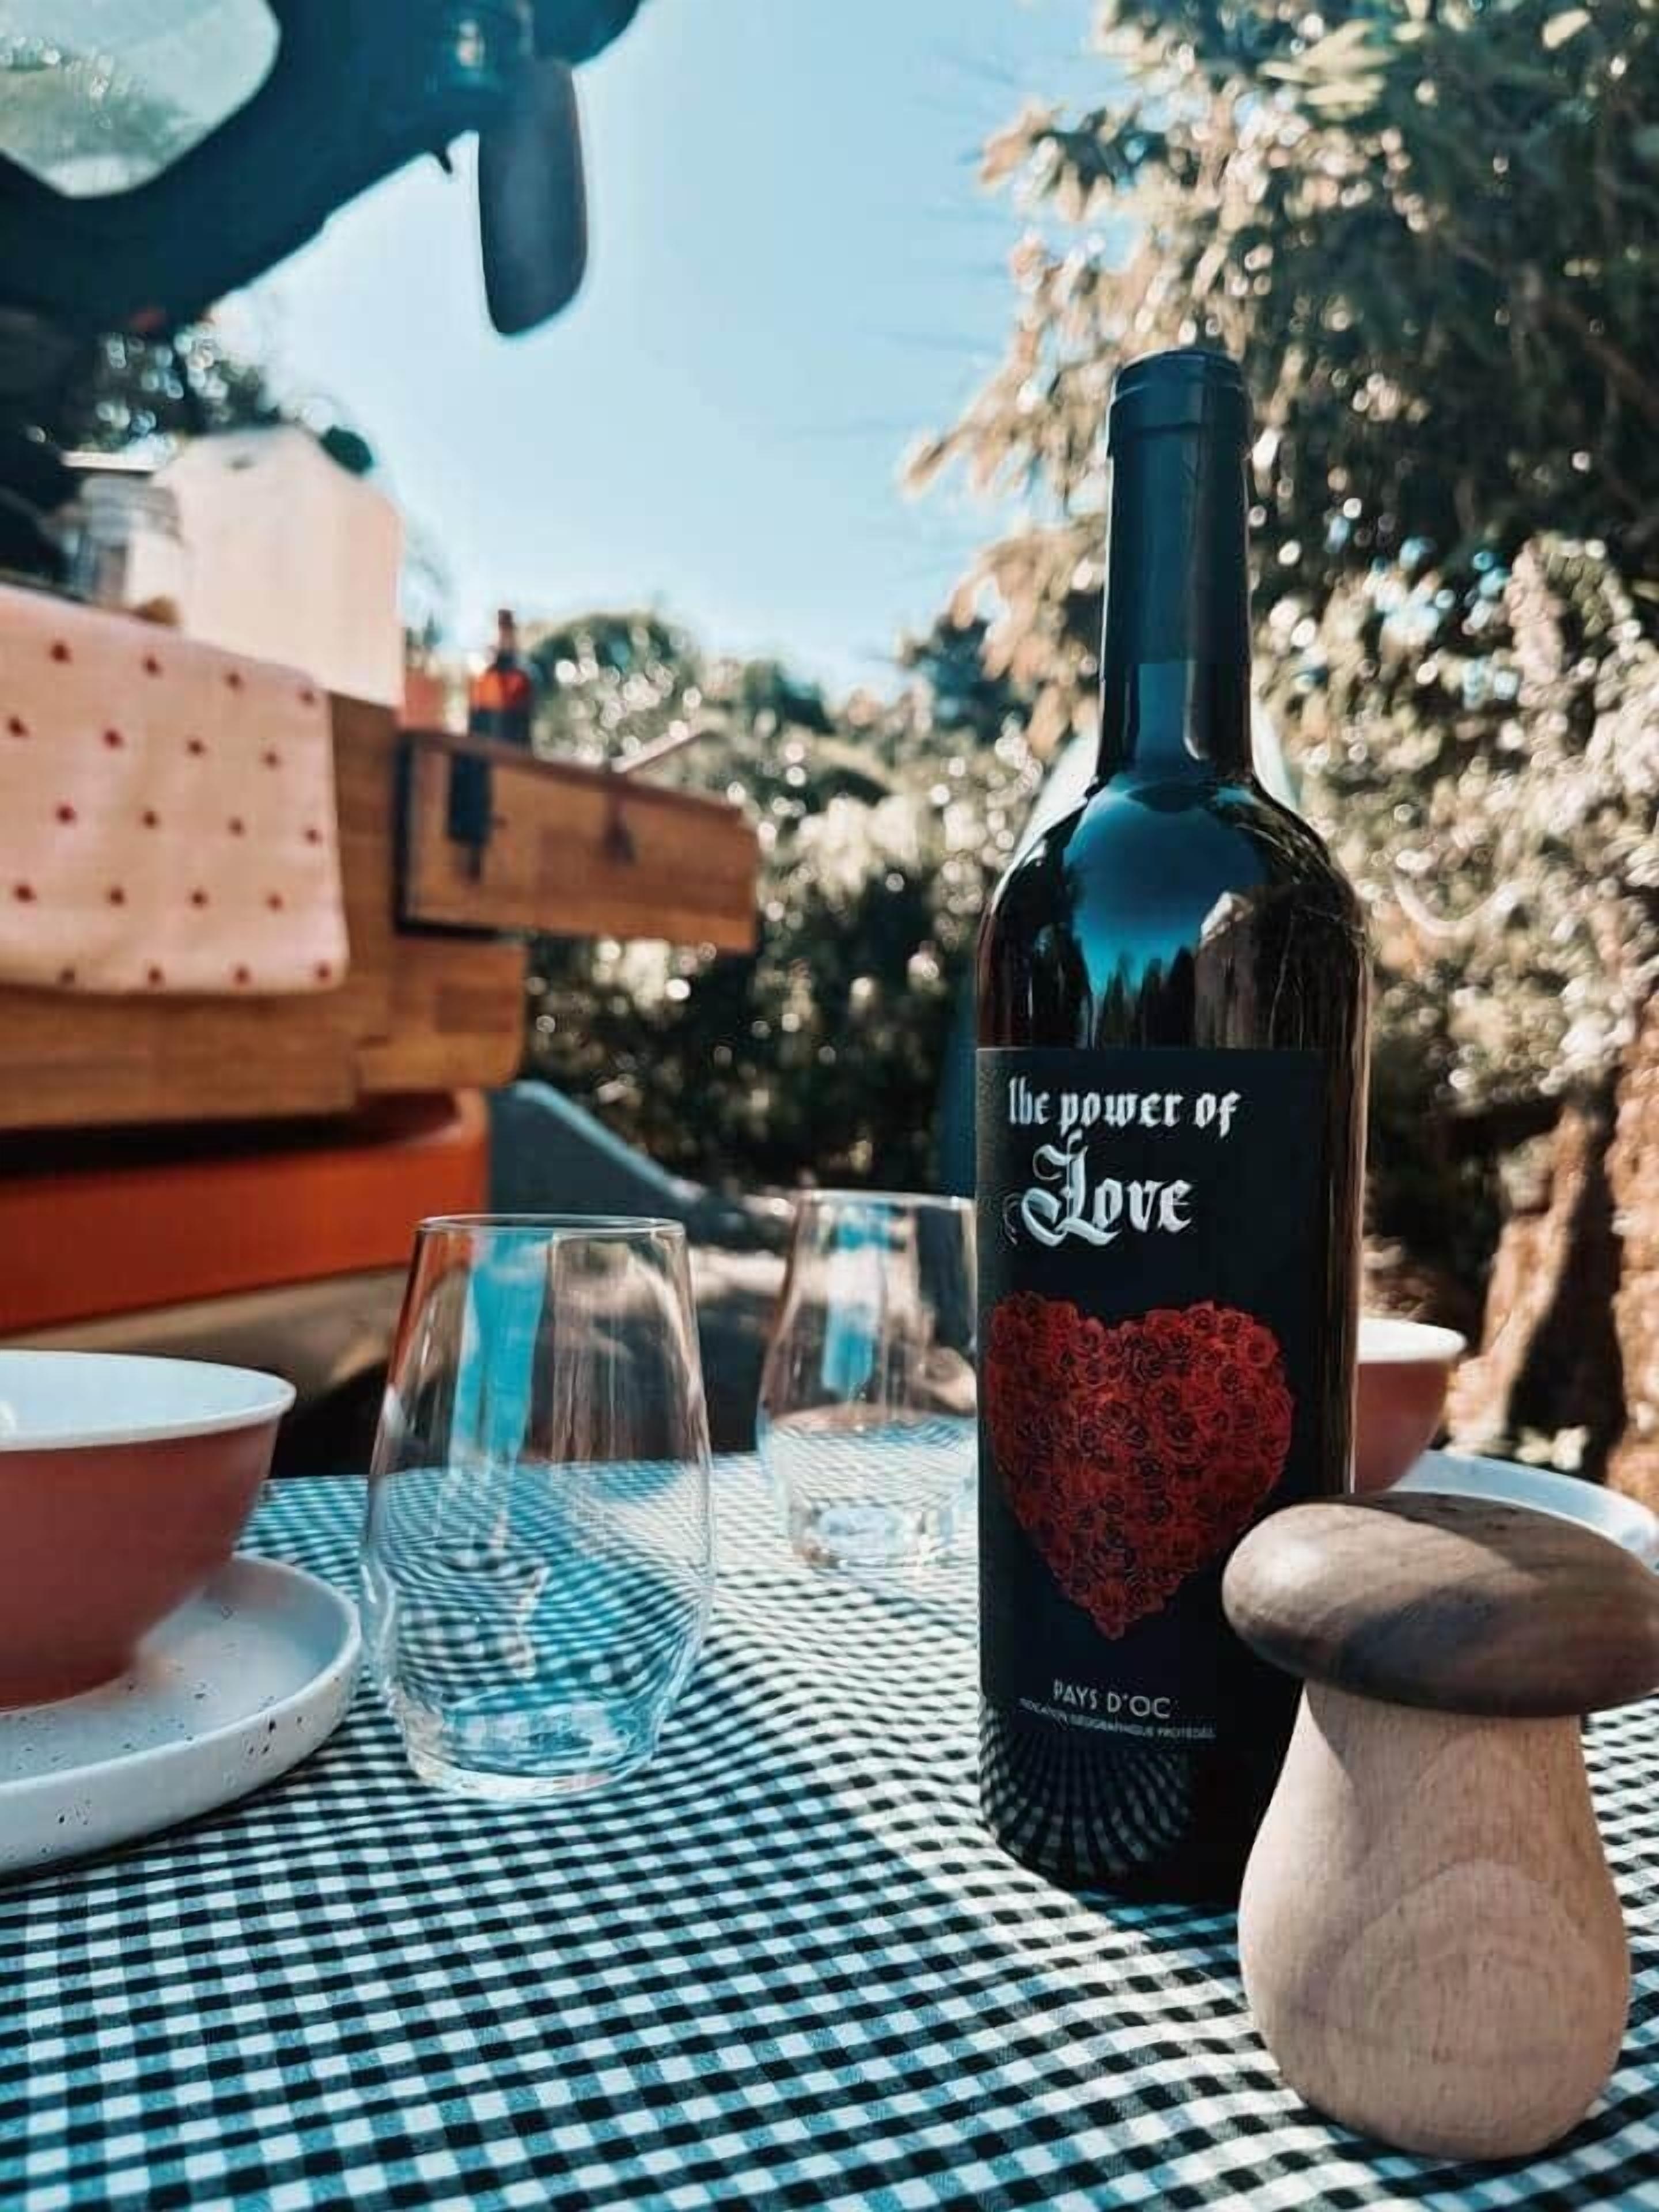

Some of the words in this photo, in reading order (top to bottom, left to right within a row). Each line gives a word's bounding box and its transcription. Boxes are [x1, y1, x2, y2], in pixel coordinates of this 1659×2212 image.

[1009, 1077, 1050, 1125] the
[1059, 1092, 1184, 1135] power
[1194, 1091, 1241, 1139] of
[1020, 1128, 1194, 1247] Love
[1053, 1678, 1098, 1710] PAYS
[1107, 1691, 1171, 1719] D'OC
